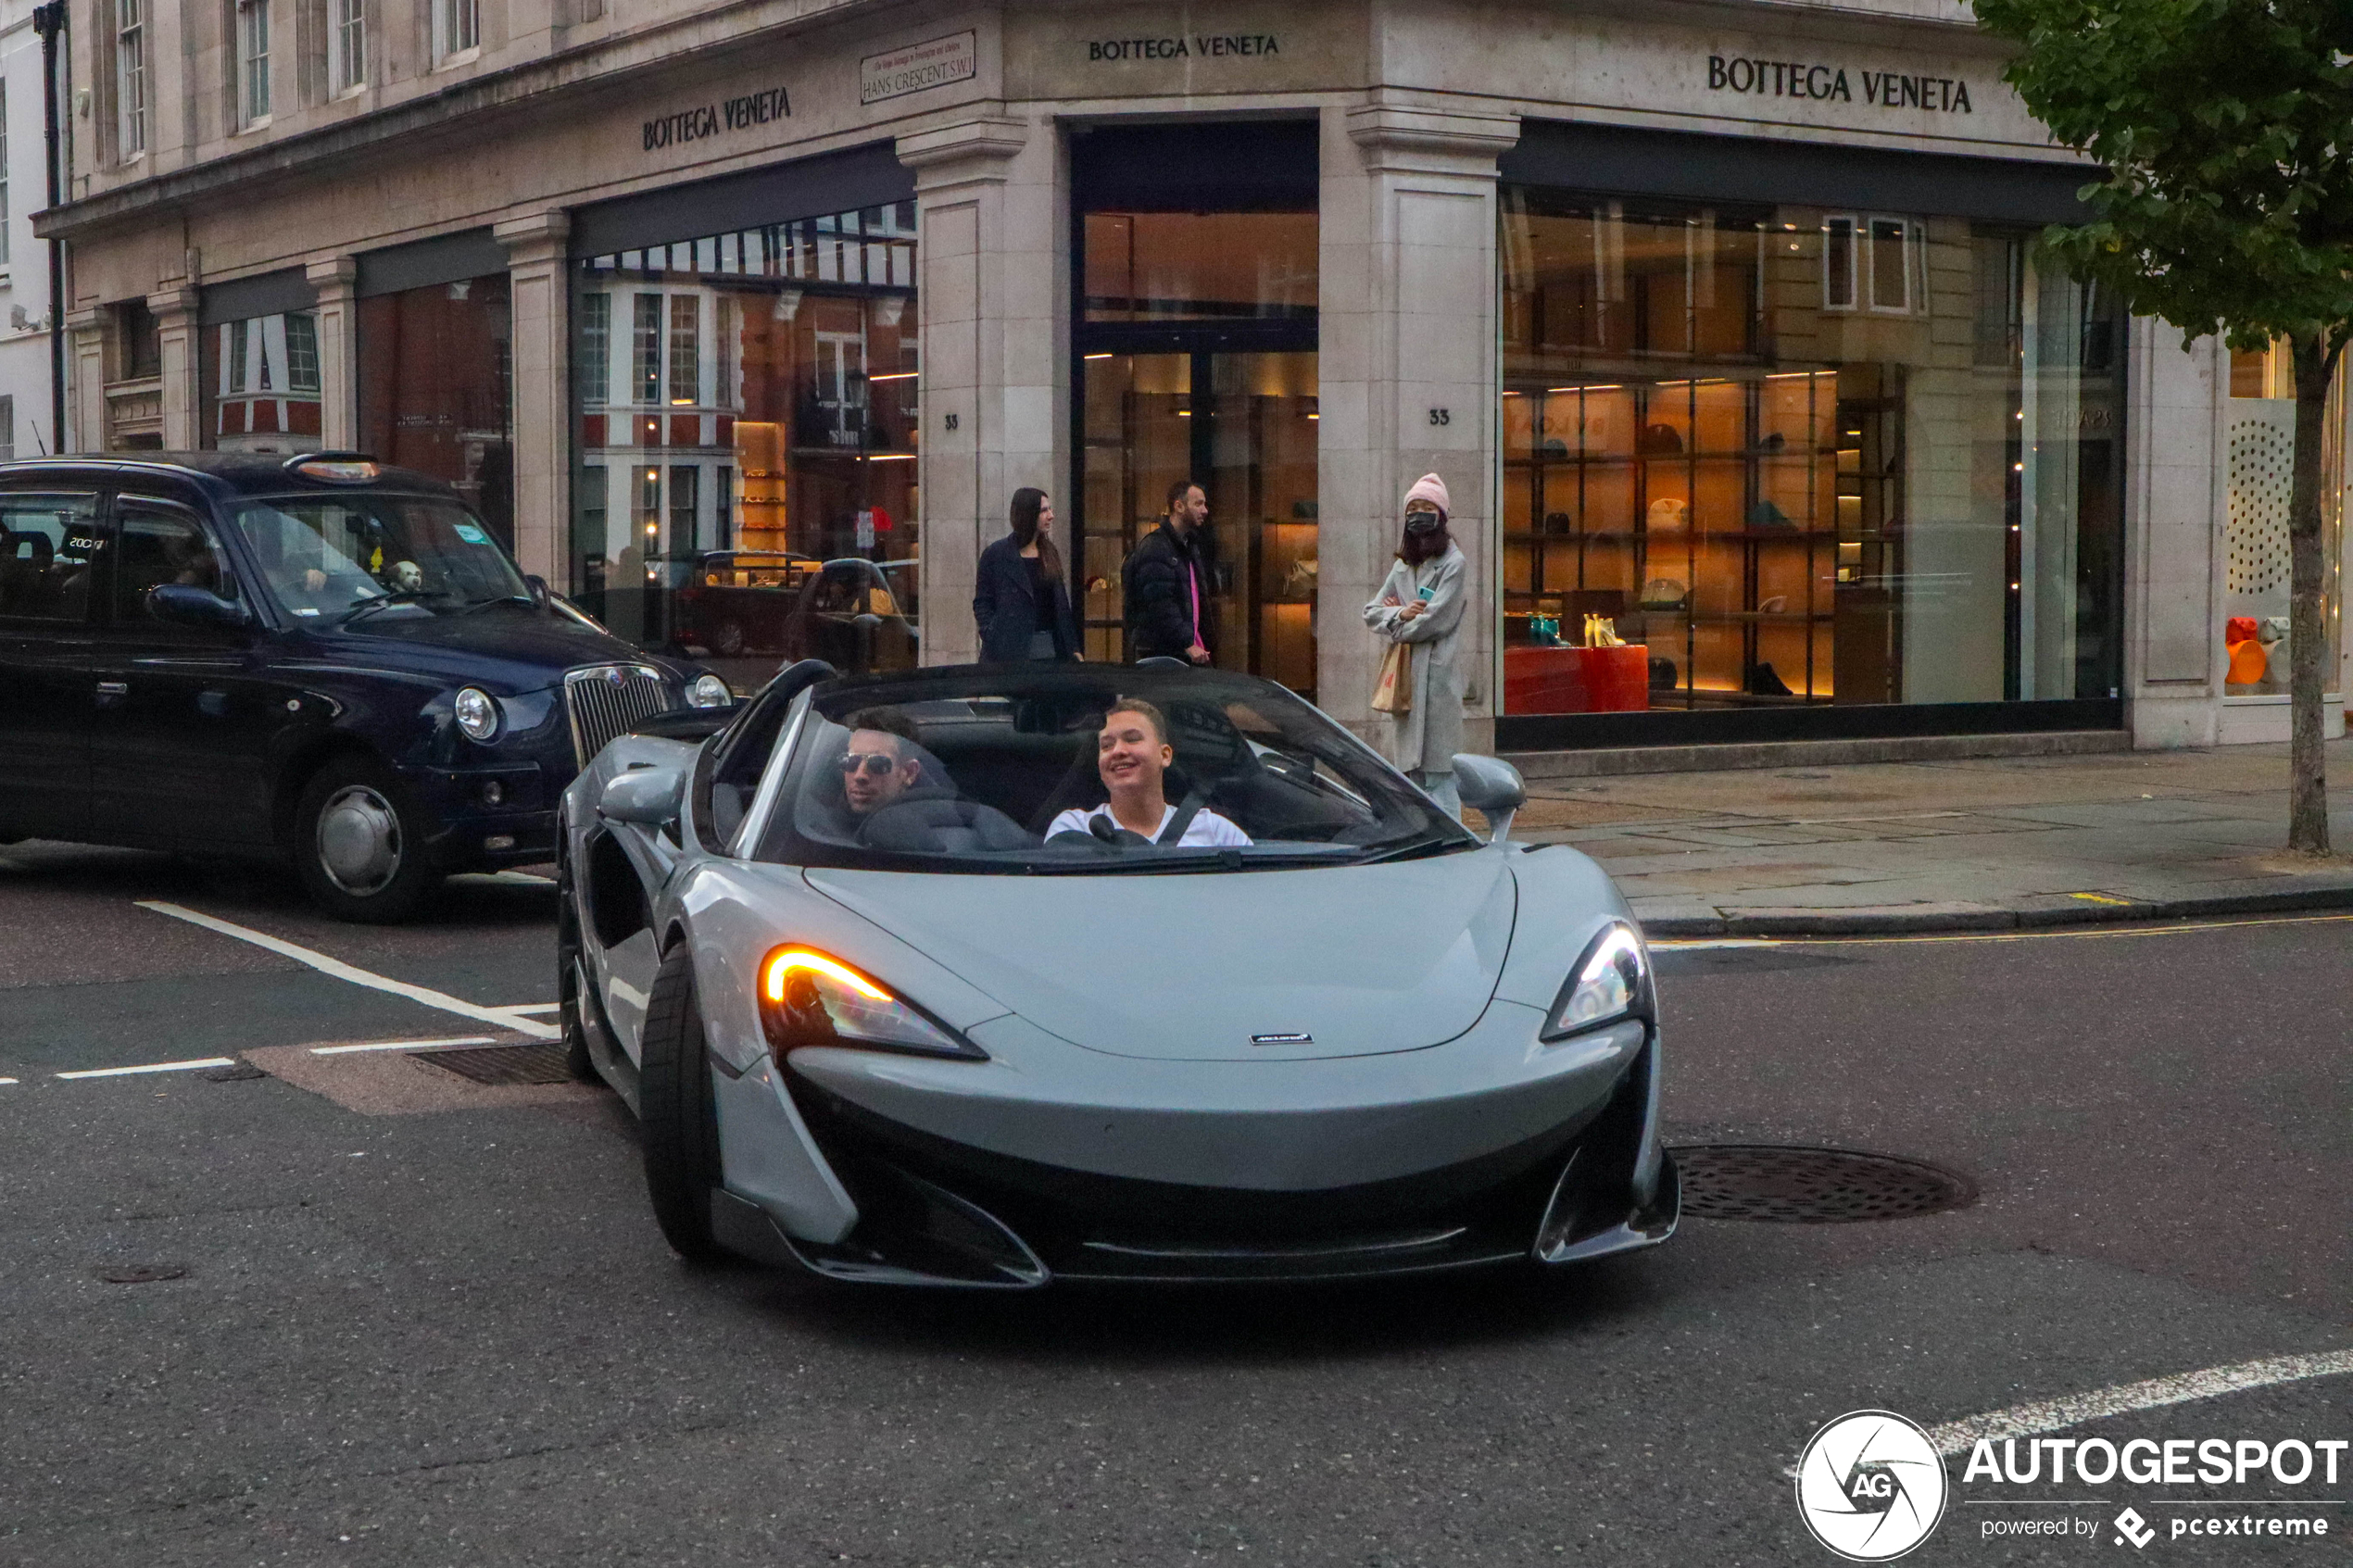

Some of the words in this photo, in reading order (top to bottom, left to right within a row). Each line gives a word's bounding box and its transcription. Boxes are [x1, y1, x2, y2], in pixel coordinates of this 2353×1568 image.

[1089, 39, 1189, 61] BOTTEGA
[1197, 35, 1279, 56] VENETA
[863, 77, 891, 99] HANS
[1708, 56, 1852, 102] BOTTEGA
[1862, 71, 1972, 113] VENETA
[643, 105, 719, 151] BOTTEGA
[724, 86, 790, 131] VENETA
